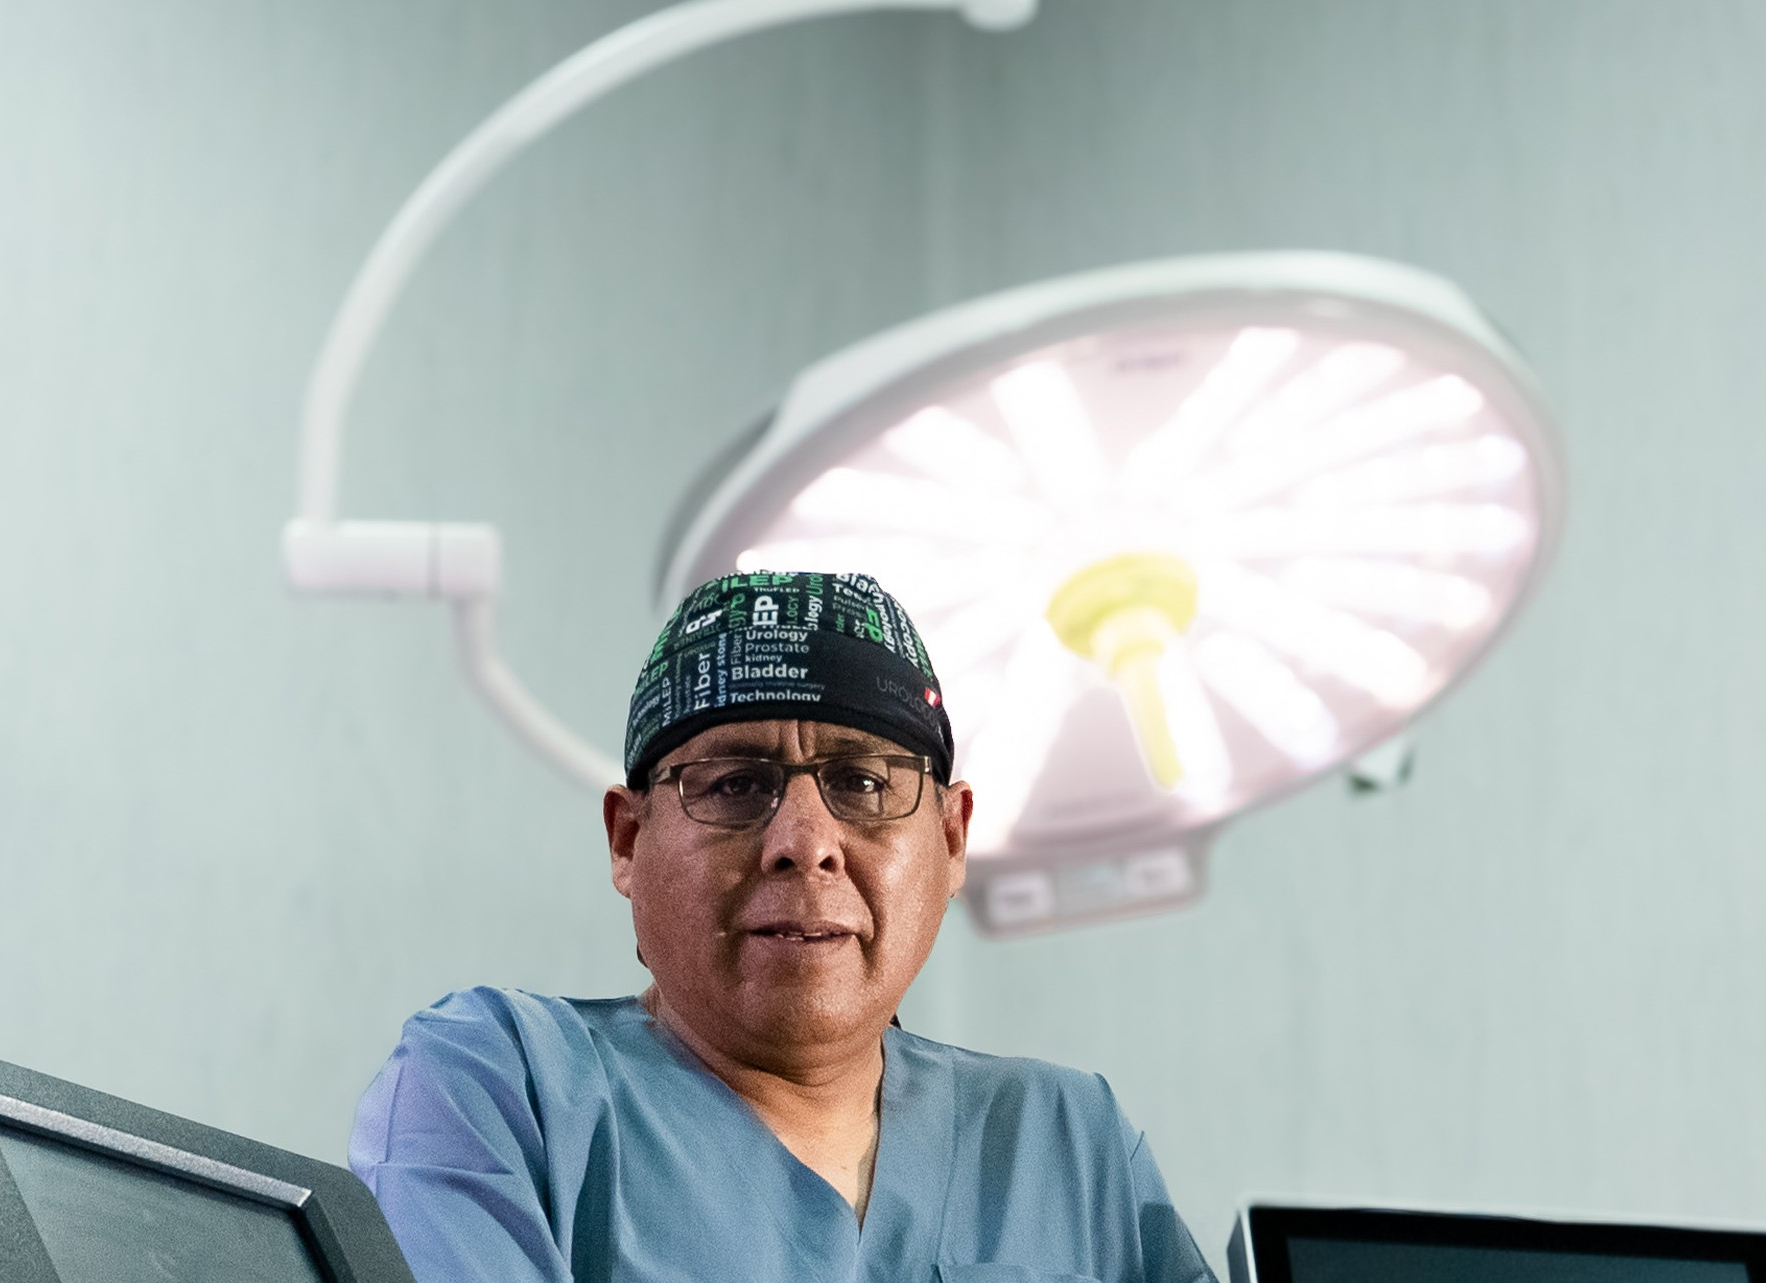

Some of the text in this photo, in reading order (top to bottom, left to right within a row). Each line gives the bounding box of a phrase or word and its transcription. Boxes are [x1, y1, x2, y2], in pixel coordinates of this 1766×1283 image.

[746, 629, 808, 642] Urology
[745, 643, 810, 654] Prostate
[745, 654, 783, 663] kidney
[731, 663, 809, 681] Bladder
[693, 652, 711, 711] Fiber
